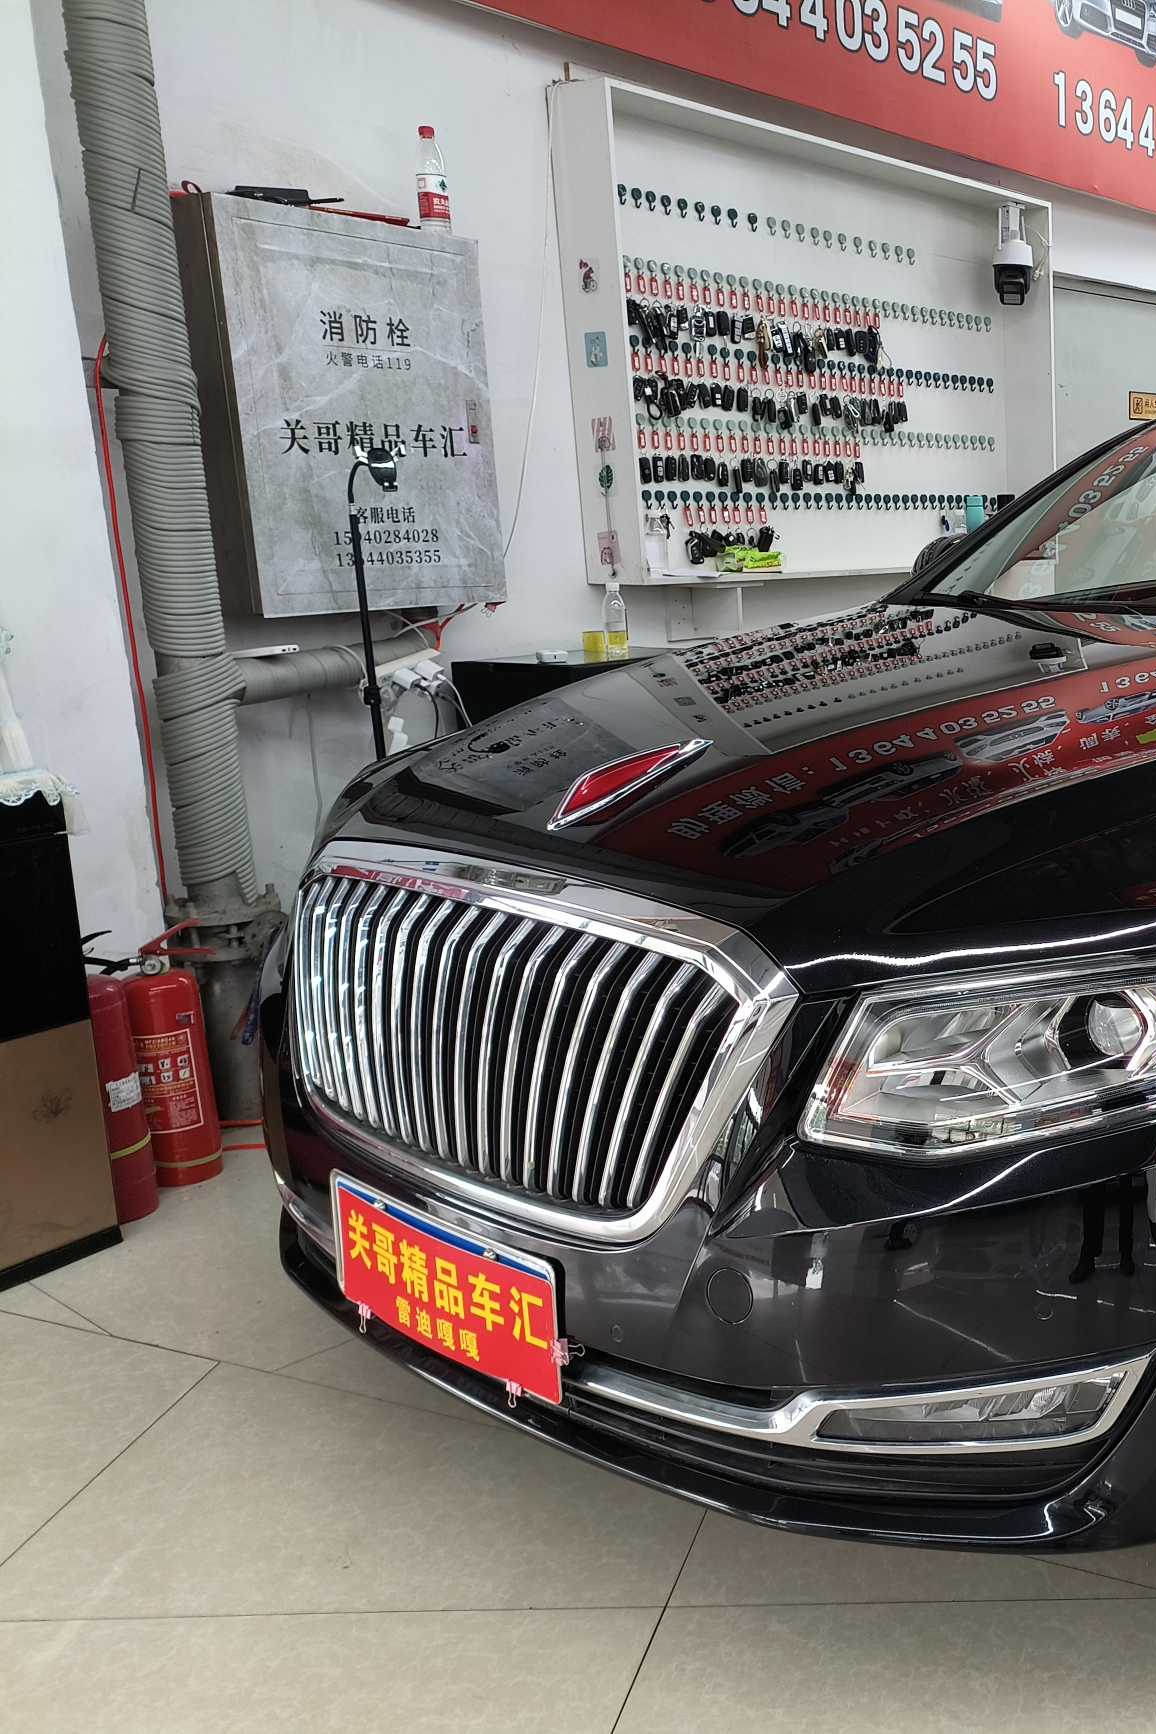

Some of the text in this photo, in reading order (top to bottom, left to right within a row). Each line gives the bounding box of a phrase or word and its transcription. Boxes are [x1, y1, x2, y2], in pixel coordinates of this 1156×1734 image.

[319, 310, 411, 348] 消防栓
[326, 351, 412, 371] 火警电话119
[280, 418, 468, 459] 关哥精品车汇
[356, 506, 417, 525] 客服电话
[333, 528, 439, 547] 1540284028
[336, 549, 442, 568] 1344035355
[348, 1209, 548, 1351] 关哥精品车汇
[395, 1295, 480, 1362] 雷迪嘎嘎
